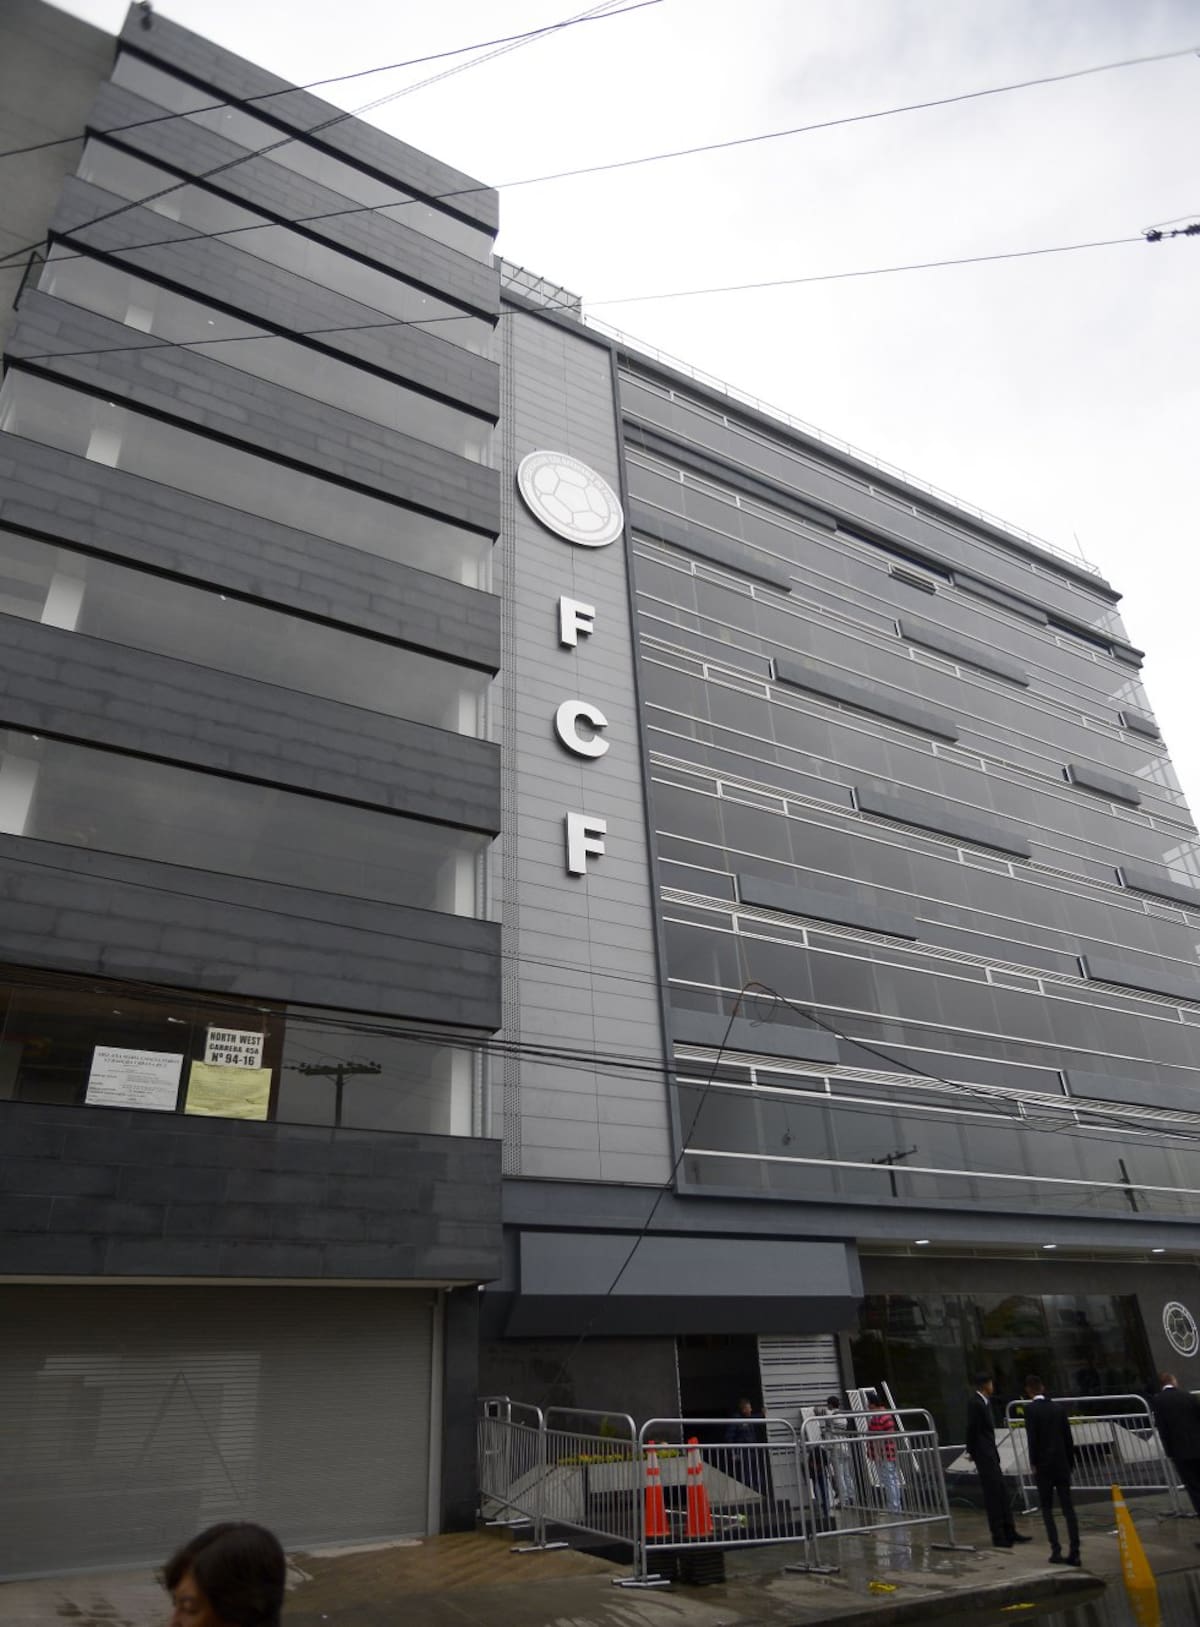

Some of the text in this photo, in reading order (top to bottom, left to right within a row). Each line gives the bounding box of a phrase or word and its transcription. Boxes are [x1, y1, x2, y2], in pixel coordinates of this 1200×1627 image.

[210, 1032, 261, 1046] NORTH WEST
[225, 1053, 255, 1066] 94-16
